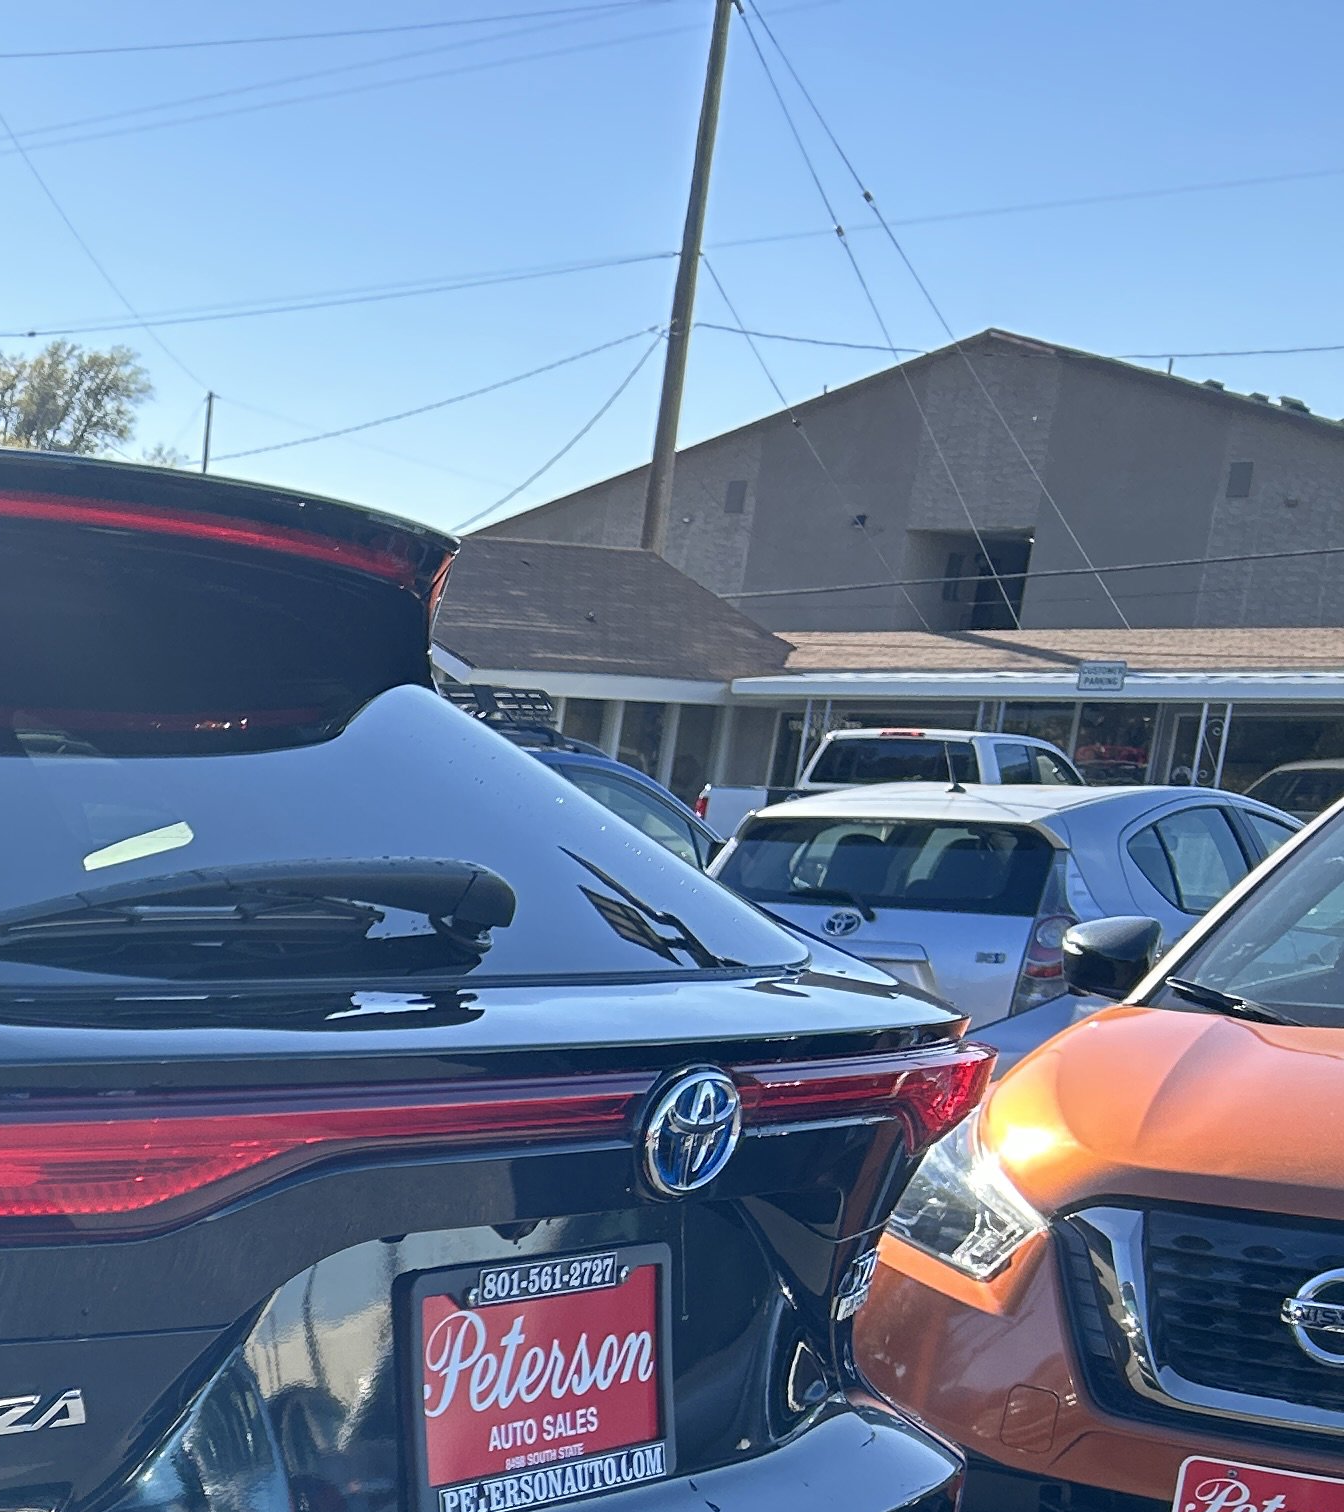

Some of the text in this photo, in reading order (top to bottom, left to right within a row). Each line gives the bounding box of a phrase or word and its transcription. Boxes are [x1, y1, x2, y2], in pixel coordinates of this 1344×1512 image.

[483, 1257, 614, 1299] 801-561-2727
[424, 1309, 655, 1418] Peterson
[488, 1407, 599, 1452] AUTO SALES
[558, 1442, 585, 1459] STATE
